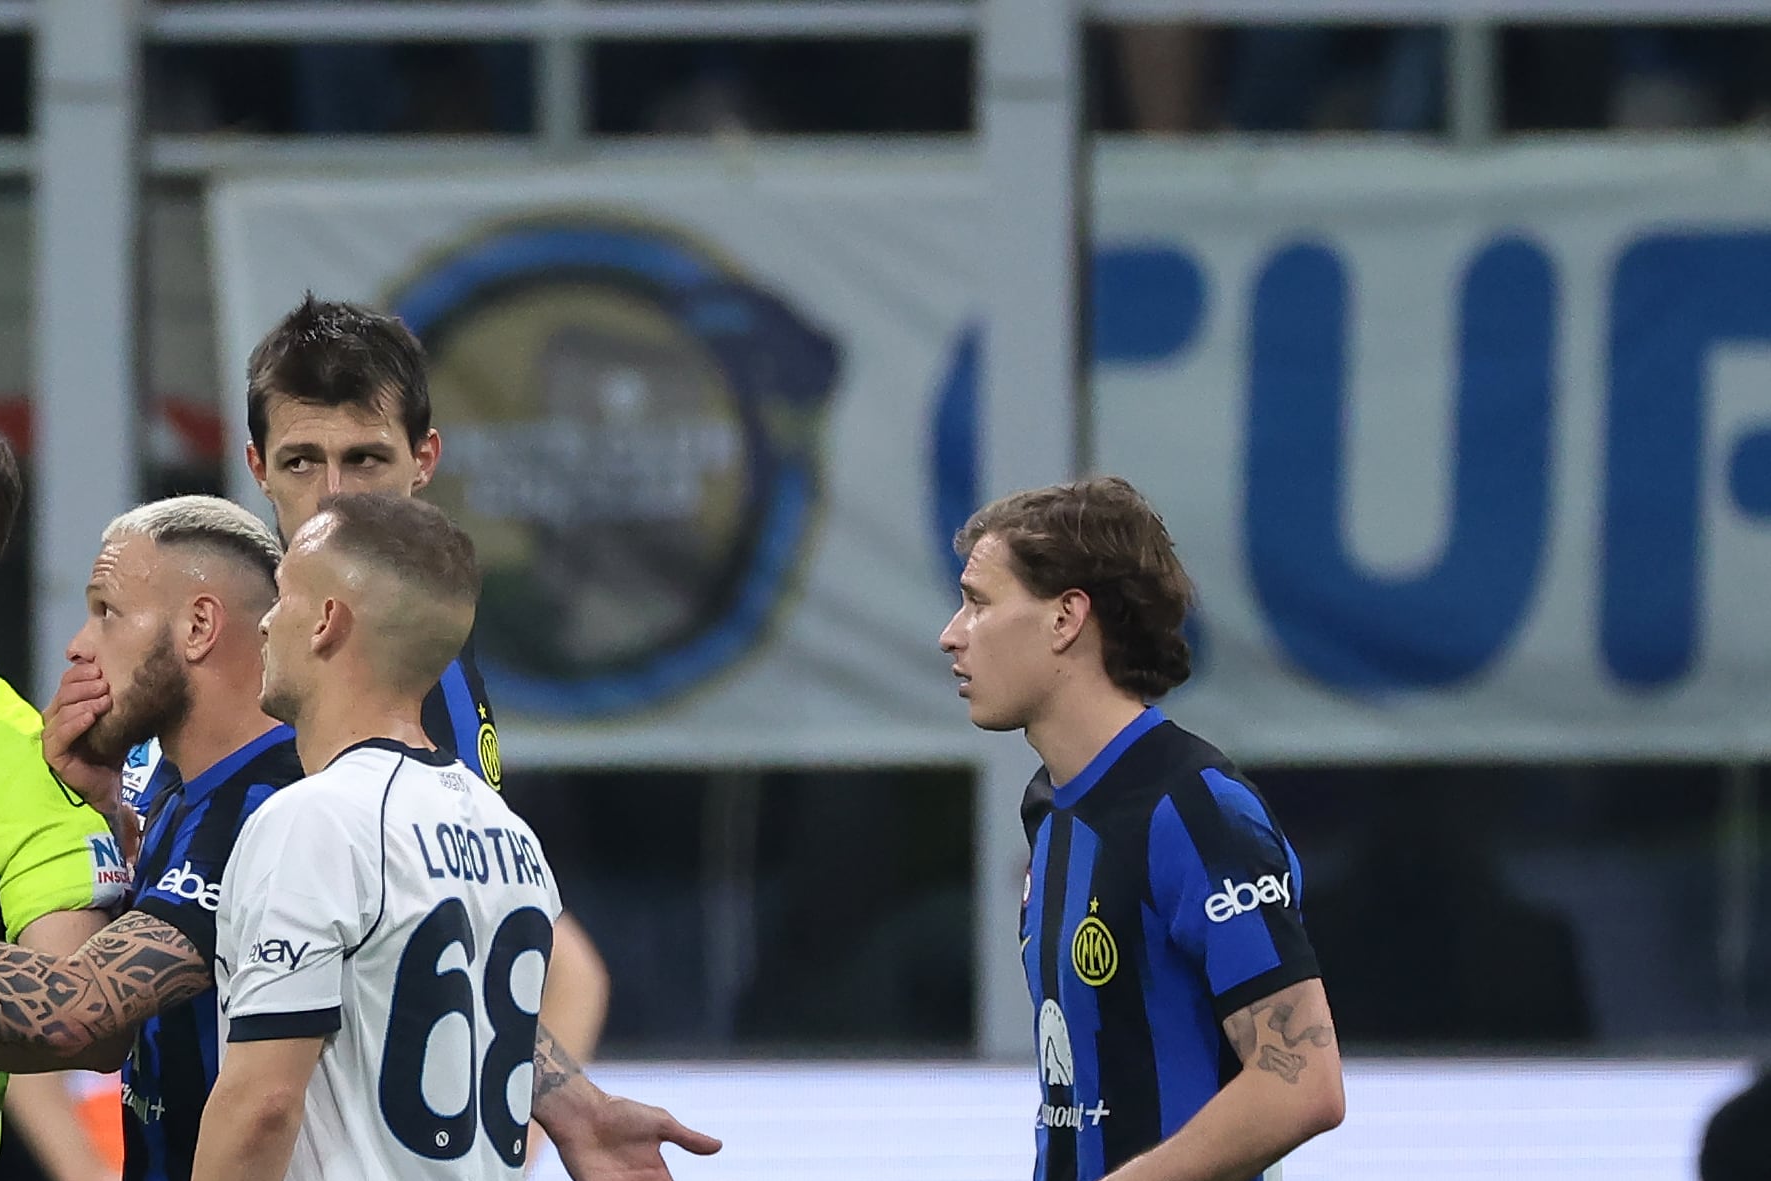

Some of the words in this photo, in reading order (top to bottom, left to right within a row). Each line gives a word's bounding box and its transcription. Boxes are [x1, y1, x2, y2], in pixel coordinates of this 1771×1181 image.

[412, 822, 548, 890] LOBOTKA
[1205, 871, 1290, 922] ebay
[379, 897, 554, 1168] 68
